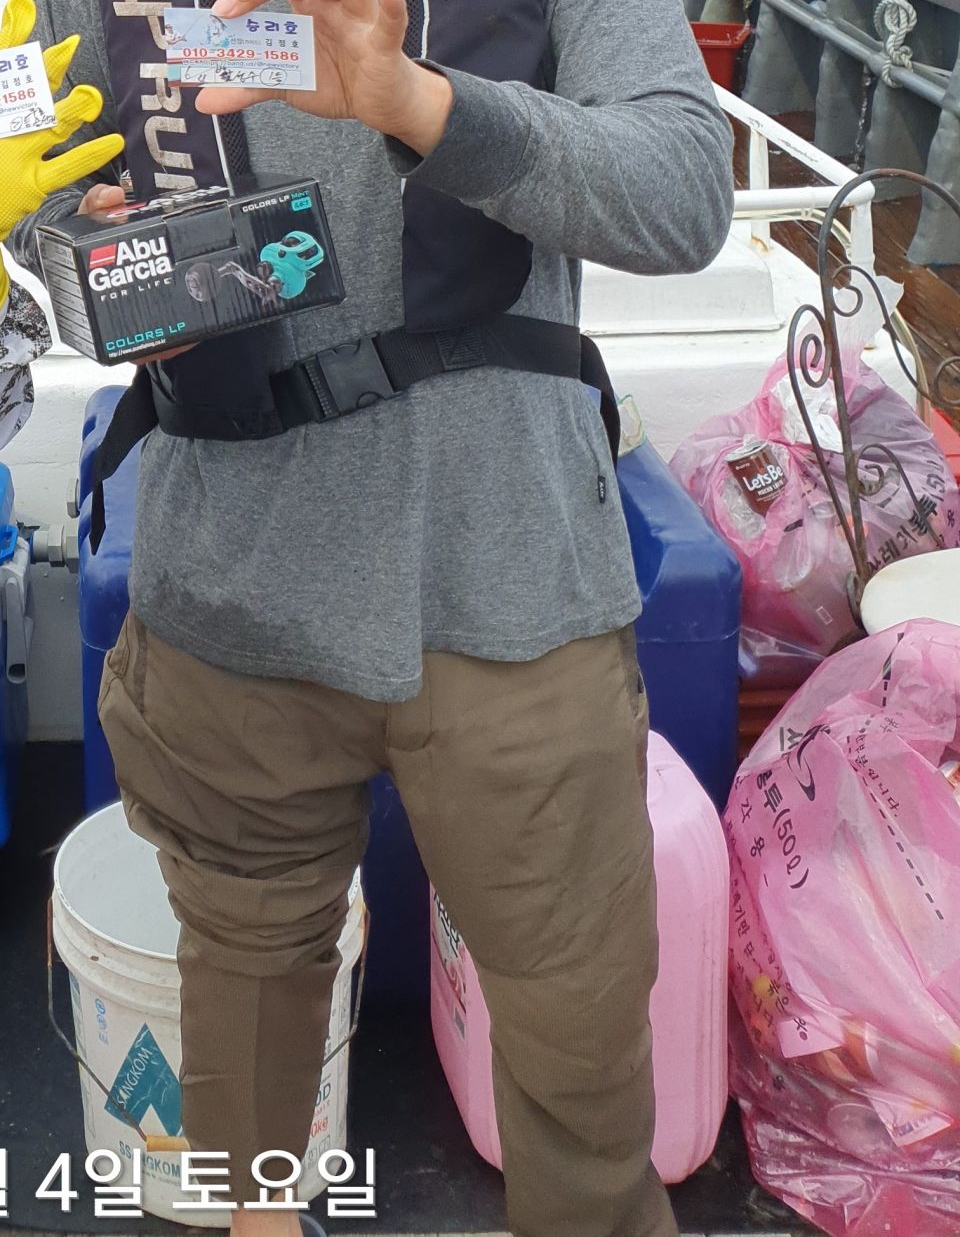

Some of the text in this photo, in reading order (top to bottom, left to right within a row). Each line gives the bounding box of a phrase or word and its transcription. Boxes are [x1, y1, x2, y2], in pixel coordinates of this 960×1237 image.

[246, 18, 298, 35] 승리호
[183, 48, 299, 61] 010-3429-1586
[242, 197, 277, 213] COLORS
[278, 194, 290, 203] LP
[116, 237, 168, 266] Abu
[88, 256, 173, 291] Garcia
[100, 277, 173, 302] FOR LIFE
[105, 321, 186, 351] COLORS LP
[119, 1140, 181, 1178] SSGKOM
